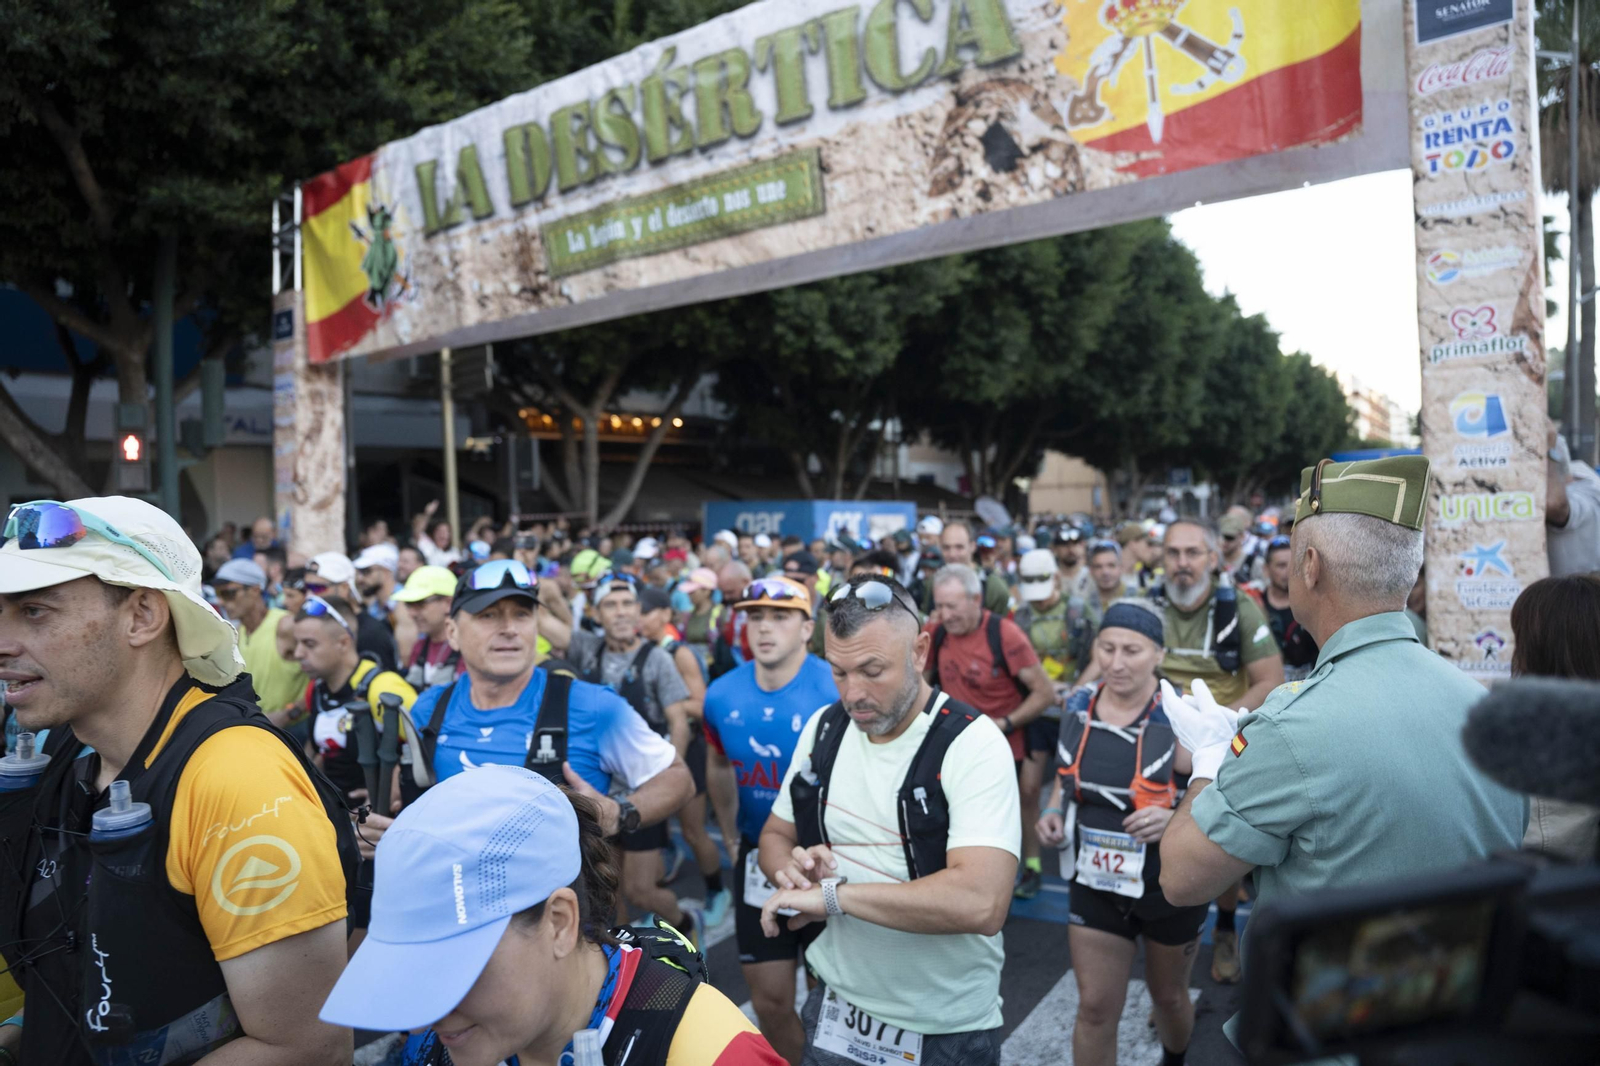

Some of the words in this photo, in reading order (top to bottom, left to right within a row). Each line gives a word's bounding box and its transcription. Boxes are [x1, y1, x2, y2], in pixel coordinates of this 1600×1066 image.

[414, 145, 494, 238] LA
[503, 0, 1022, 208] DESÉRTICA
[1424, 100, 1510, 129] GRUPO
[1425, 117, 1513, 150] RENTA
[1425, 140, 1514, 172] TODO
[631, 215, 643, 241] y
[648, 206, 662, 234] el
[723, 187, 751, 213] nos
[755, 179, 787, 204] une
[1432, 337, 1526, 363] primaflor
[1458, 454, 1508, 468] Activa
[1441, 491, 1534, 521] unica
[1092, 851, 1125, 874] 412
[452, 863, 467, 925] SALOMON
